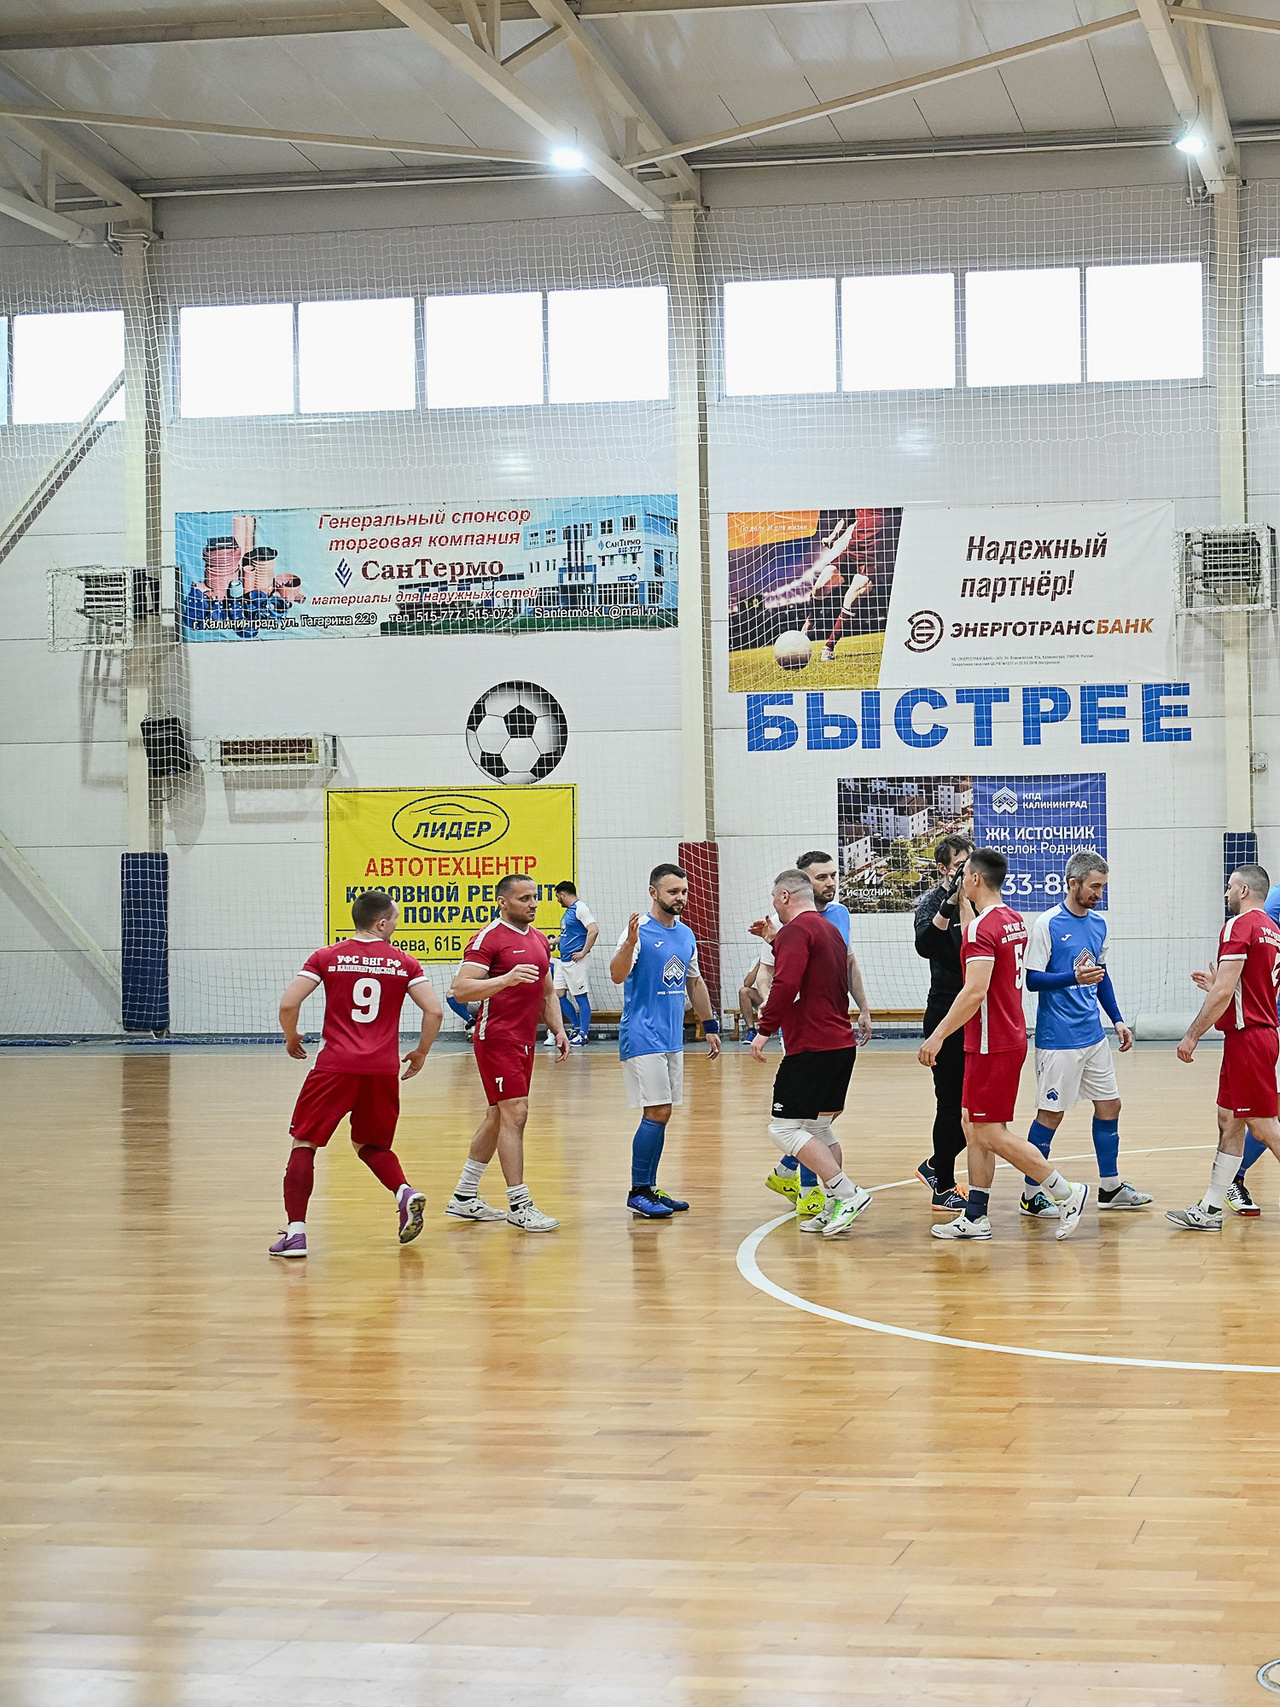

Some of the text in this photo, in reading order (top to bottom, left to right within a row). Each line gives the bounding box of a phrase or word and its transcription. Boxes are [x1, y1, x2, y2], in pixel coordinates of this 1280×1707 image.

[318, 509, 531, 530] Генеральный спонсор
[328, 531, 520, 553] торговая компания
[966, 532, 1108, 564] Надежный
[361, 558, 504, 583] СанТермо
[311, 587, 538, 606] материалы для наружных сетей
[960, 570, 1075, 603] партнёр!
[281, 618, 298, 629] ул.
[302, 614, 353, 627] Гагарина
[355, 612, 377, 625] 229
[467, 607, 514, 621] 515-073
[950, 618, 1155, 639] ЭНЕРГОТРАНСБАНК
[746, 682, 1193, 752] БЫСТРЕЕ
[1023, 792, 1041, 801] КПД
[1023, 801, 1087, 809] КАЛИНИНГРАД
[412, 821, 492, 841] ЛИДЕР
[985, 826, 1095, 841] ЖК ИСТОЧНИК
[365, 855, 537, 878] АВТОТЕХЦЕНТР
[468, 884, 555, 903] РЕТ
[1001, 873, 1068, 896] 33-8
[404, 905, 500, 923] ПОКРАСК
[435, 935, 461, 951] 61Б
[337, 954, 401, 968] УФС ВНГ РФ
[1014, 943, 1023, 990] 5
[351, 977, 381, 1023] 9
[495, 1077, 503, 1092] 7
